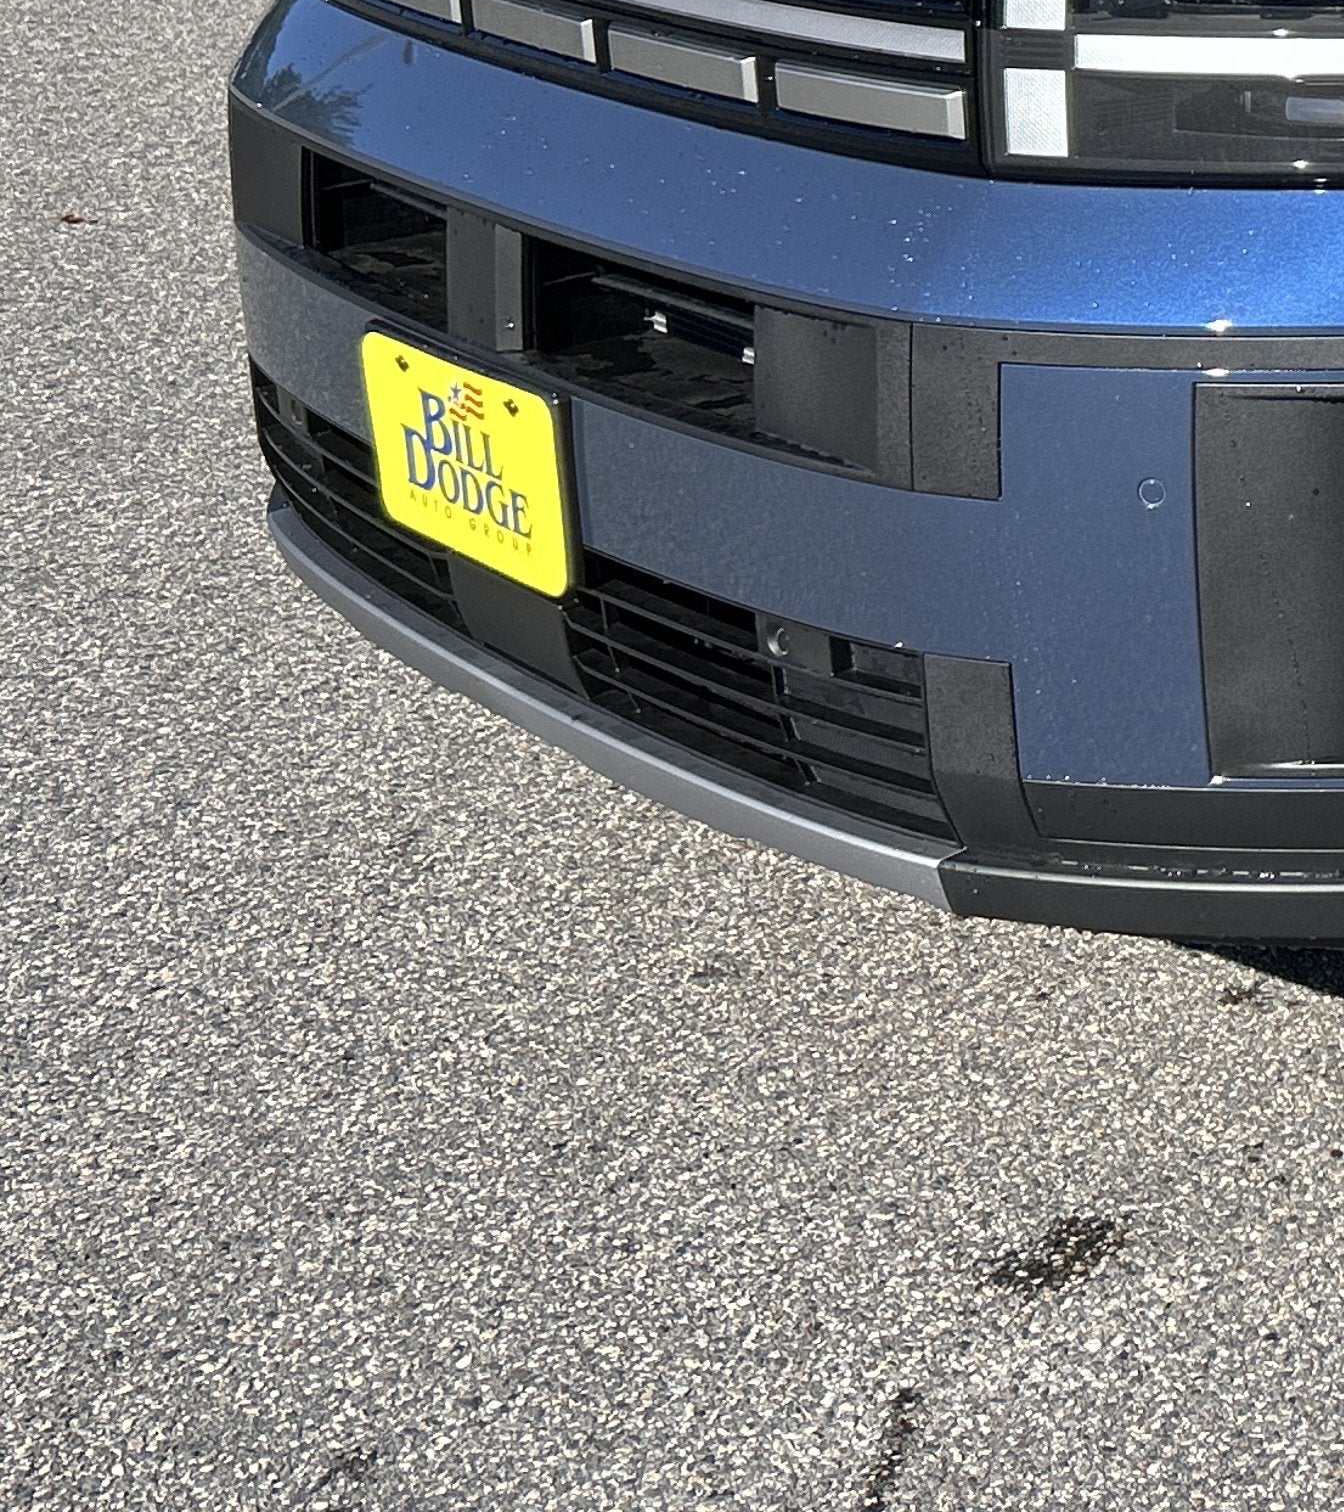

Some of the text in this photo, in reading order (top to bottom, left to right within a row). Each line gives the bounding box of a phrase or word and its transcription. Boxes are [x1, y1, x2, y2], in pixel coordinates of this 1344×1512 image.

[400, 422, 533, 539] DODGE
[417, 386, 504, 481] BILL
[409, 490, 533, 556] AUTO GROUP
